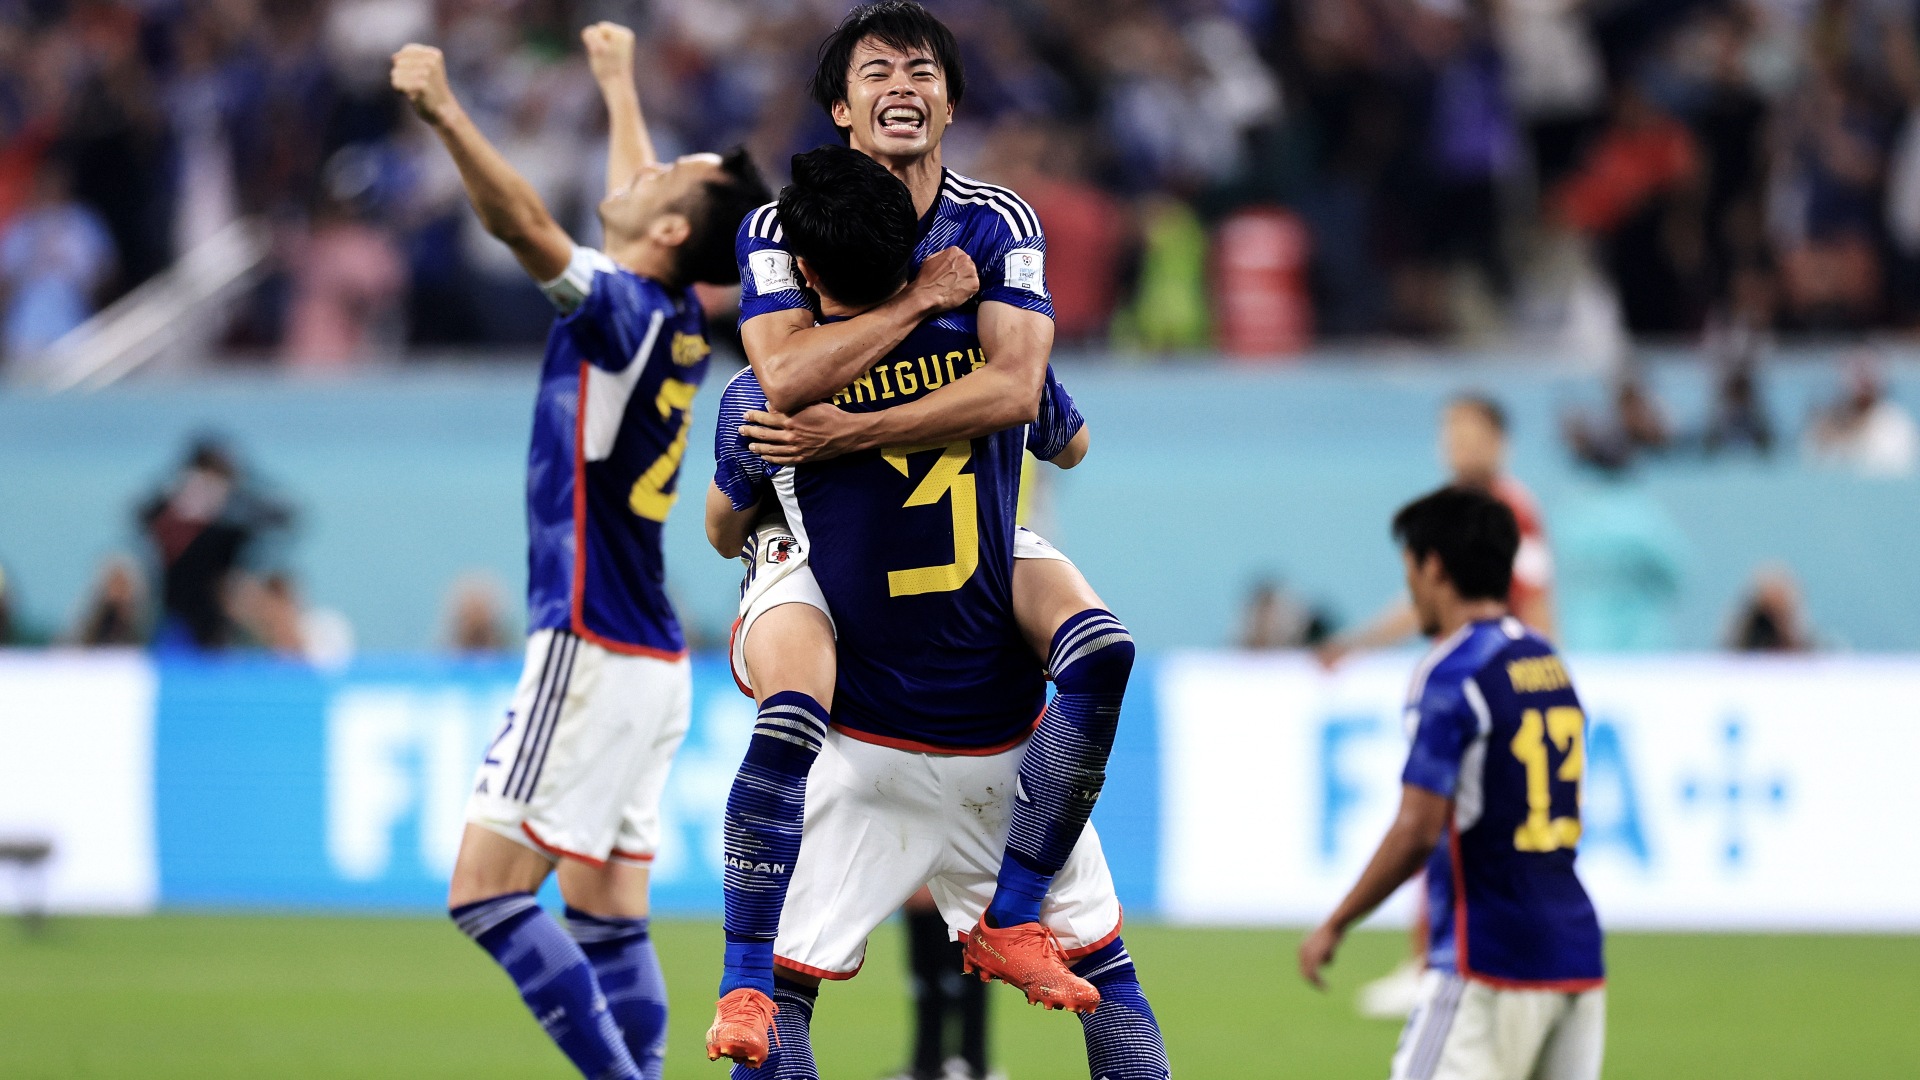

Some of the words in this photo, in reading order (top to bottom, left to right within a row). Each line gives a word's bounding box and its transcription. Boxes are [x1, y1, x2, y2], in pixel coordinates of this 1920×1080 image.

[832, 347, 987, 406] ANIGUCH
[880, 440, 979, 597] 3
[1510, 705, 1586, 853] 13
[725, 854, 786, 874] JAPAN
